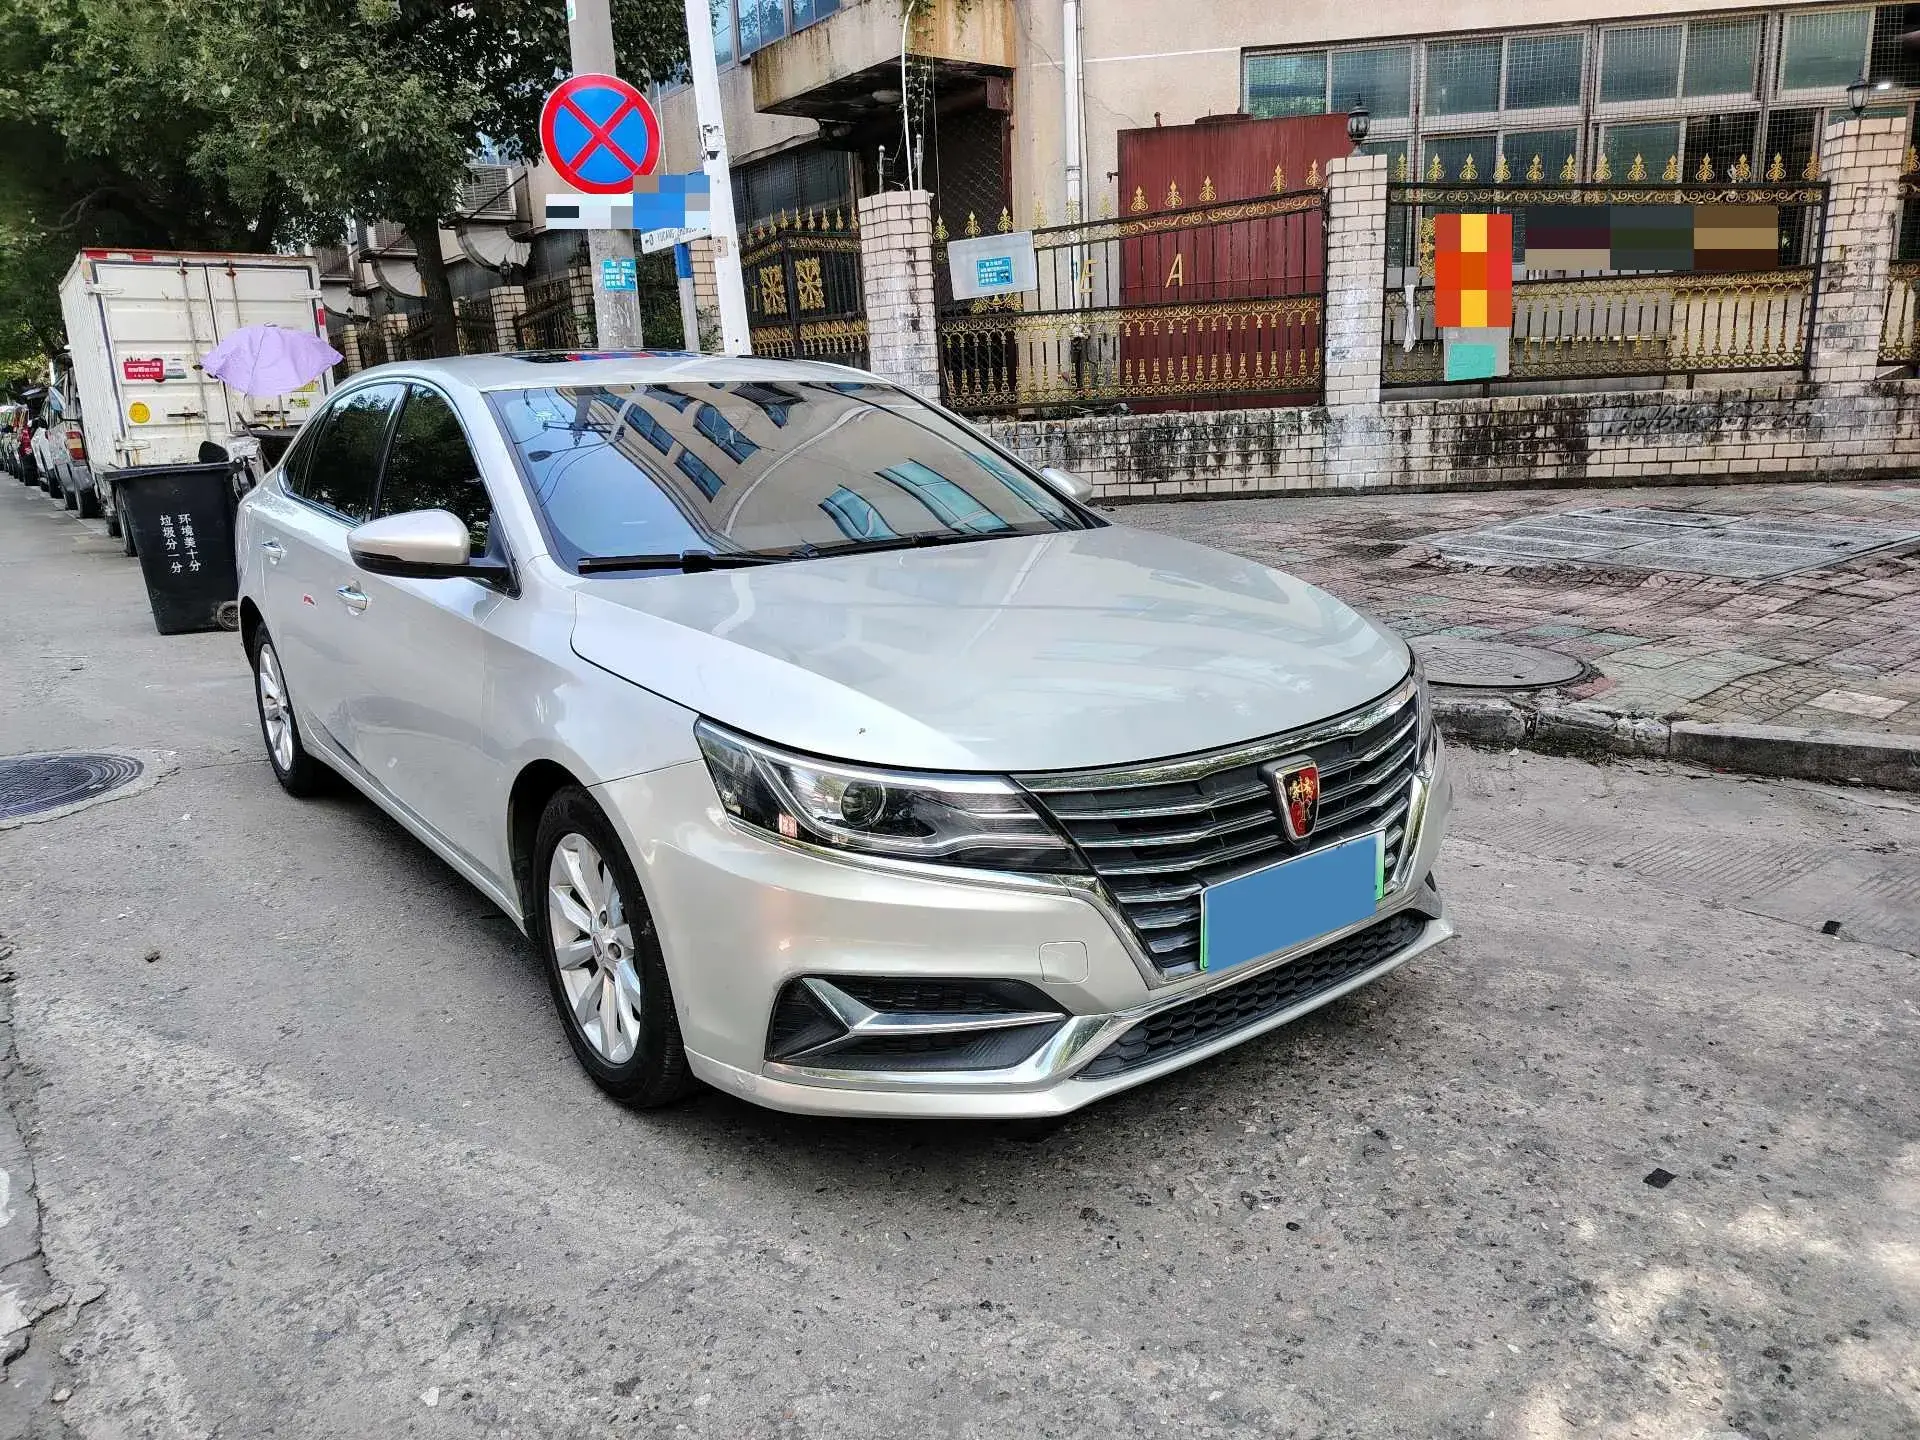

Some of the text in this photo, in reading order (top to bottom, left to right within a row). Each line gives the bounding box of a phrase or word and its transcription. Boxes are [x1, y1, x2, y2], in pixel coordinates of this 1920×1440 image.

[1165, 253, 1183, 288] A
[160, 515, 183, 573] 垃圾分一分
[178, 514, 201, 571] 环境美十分
